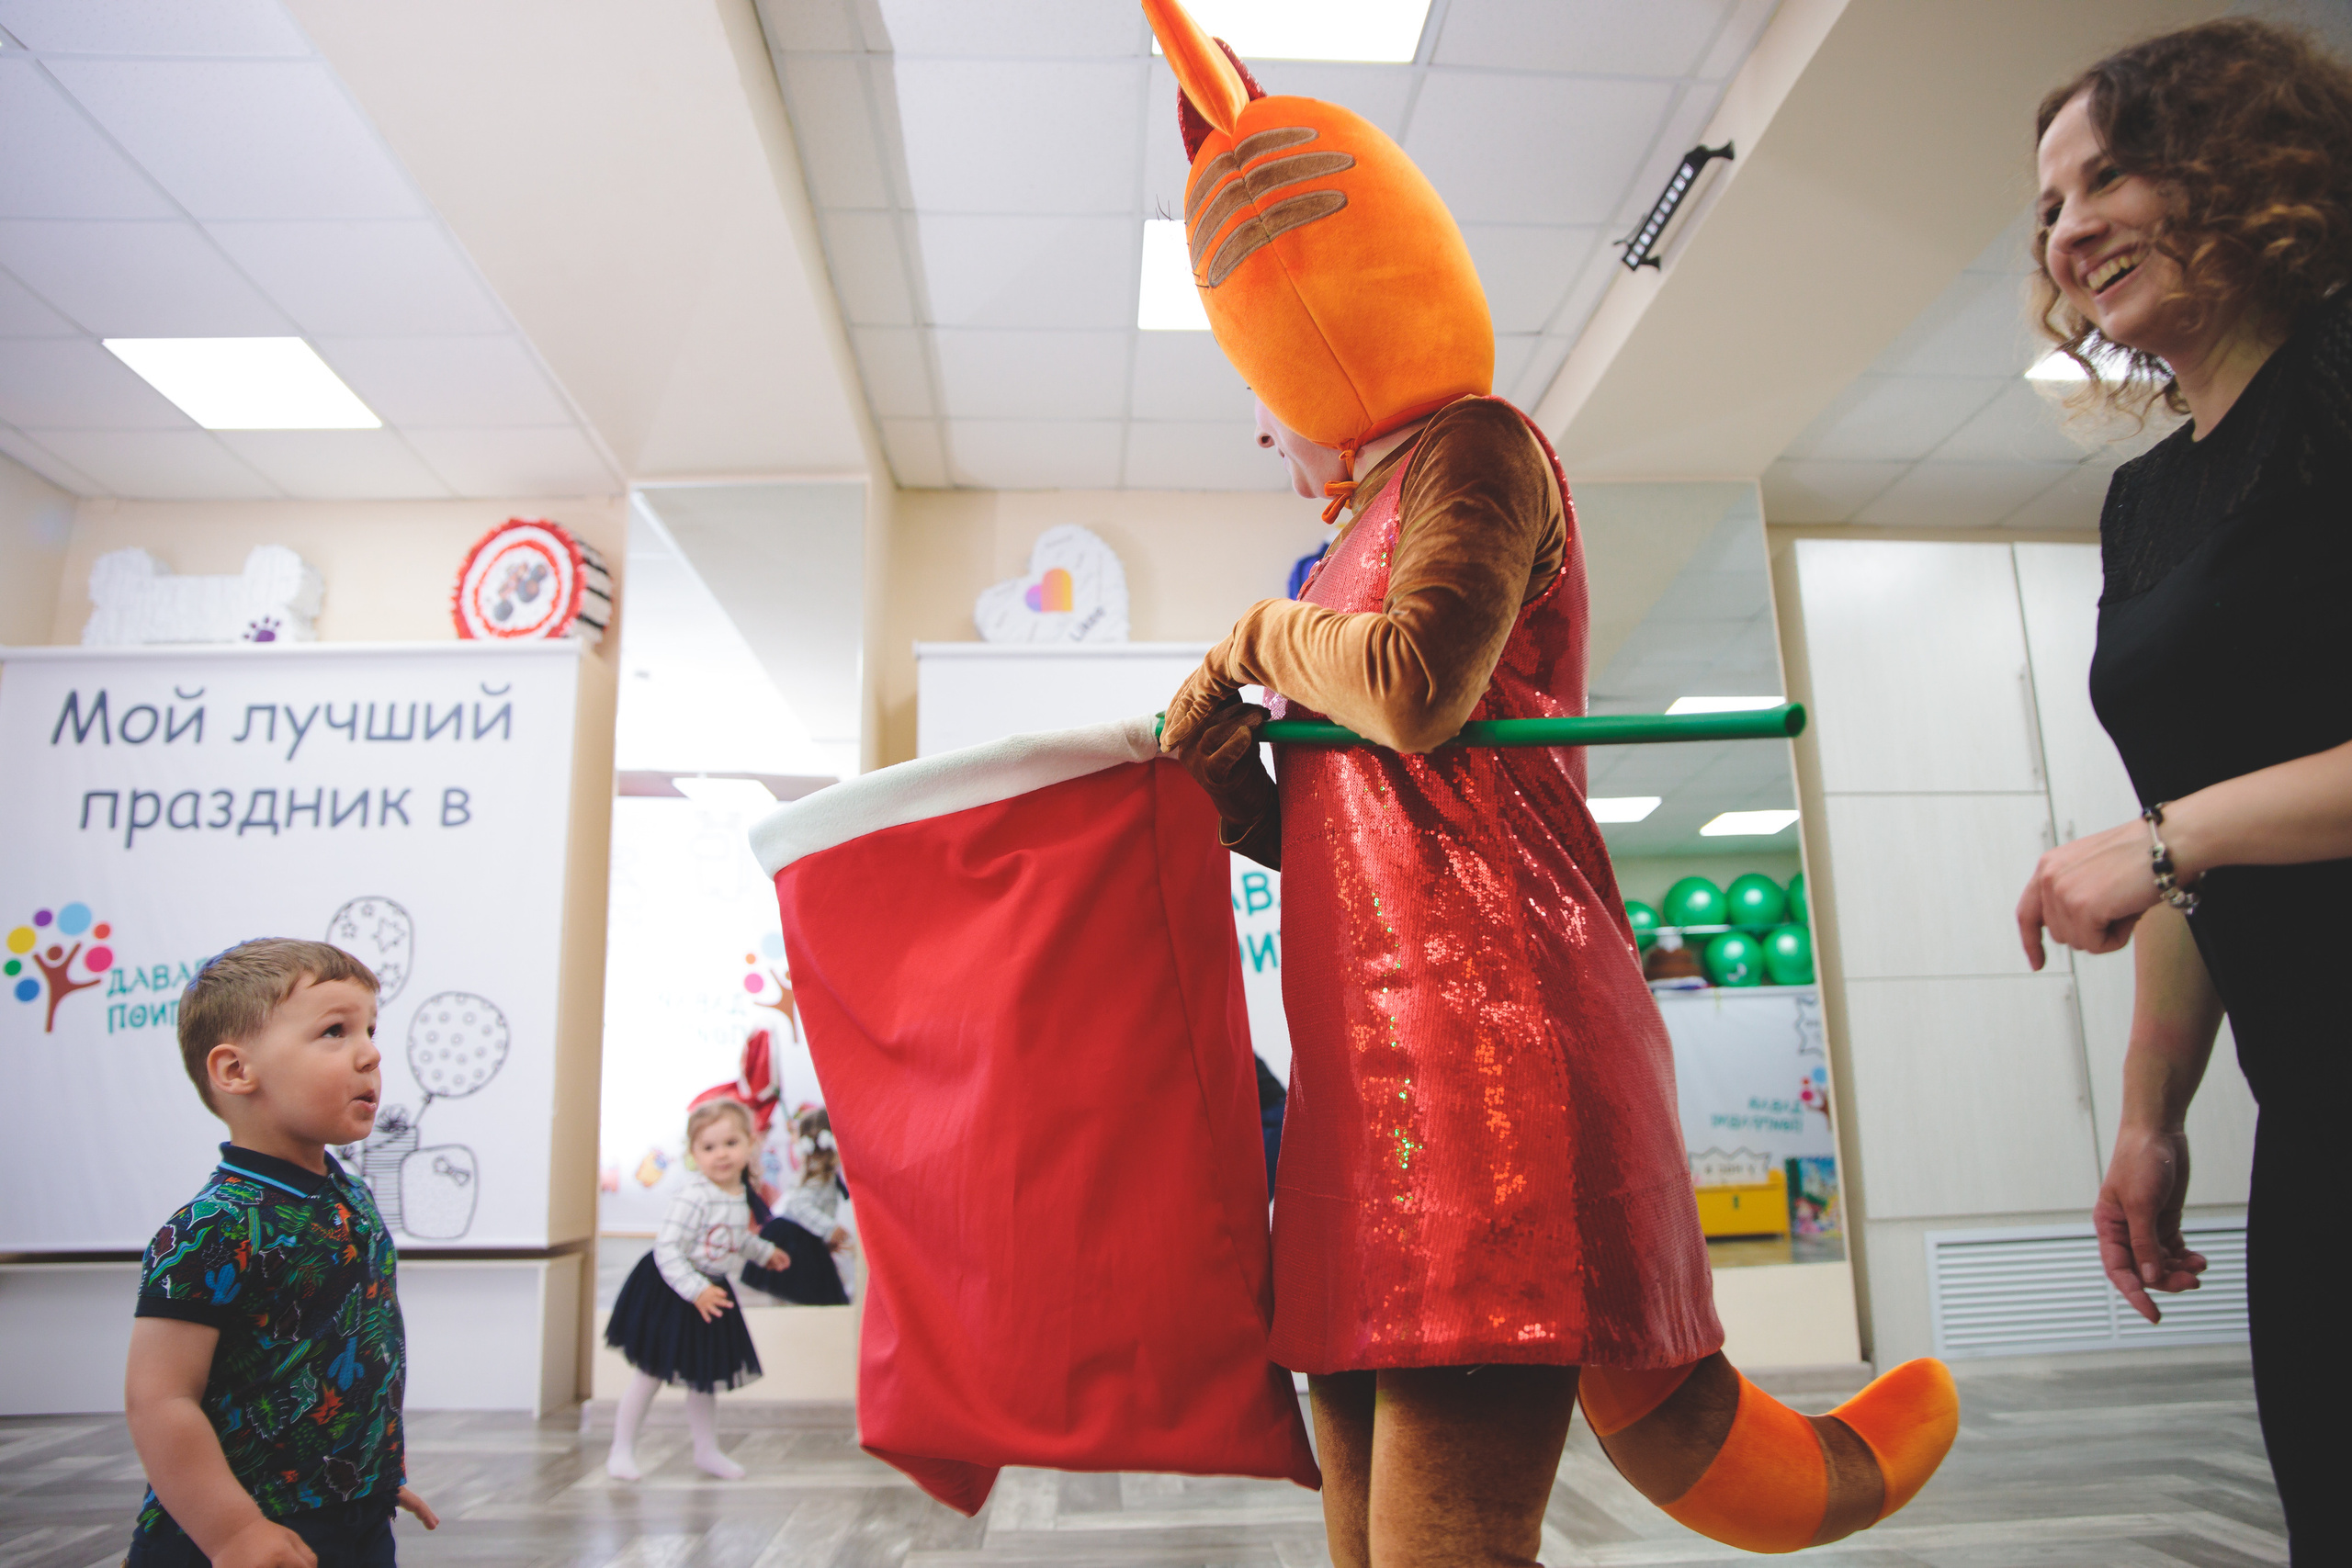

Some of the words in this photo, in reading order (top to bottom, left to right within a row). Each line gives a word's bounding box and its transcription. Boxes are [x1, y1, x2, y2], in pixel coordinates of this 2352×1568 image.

[51, 685, 206, 746] Мой
[232, 682, 512, 761] лучший
[79, 788, 412, 850] праздник
[440, 787, 471, 827] в
